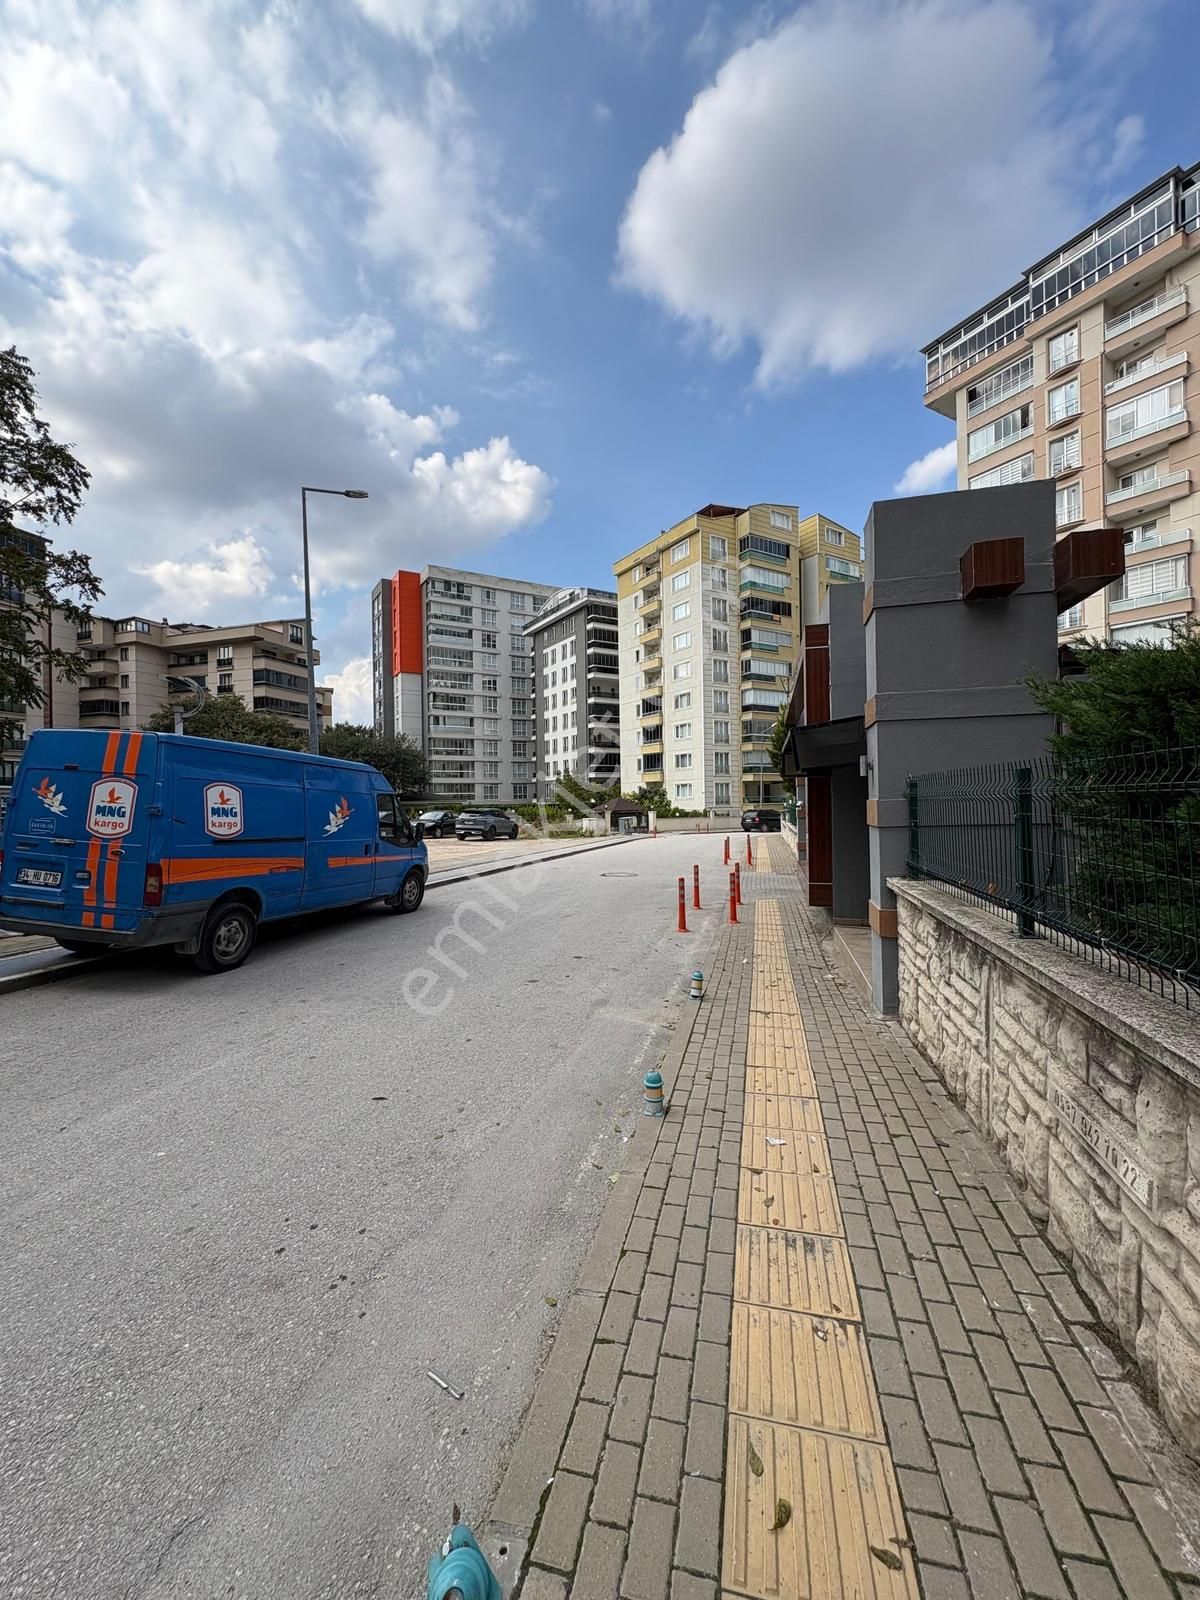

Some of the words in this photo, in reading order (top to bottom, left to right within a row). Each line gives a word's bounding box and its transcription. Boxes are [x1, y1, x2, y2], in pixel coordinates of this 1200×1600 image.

[95, 805, 127, 818] MNG
[210, 806, 238, 818] MNG
[94, 818, 124, 830] kargo
[211, 820, 238, 830] kargo
[21, 870, 29, 879] 34
